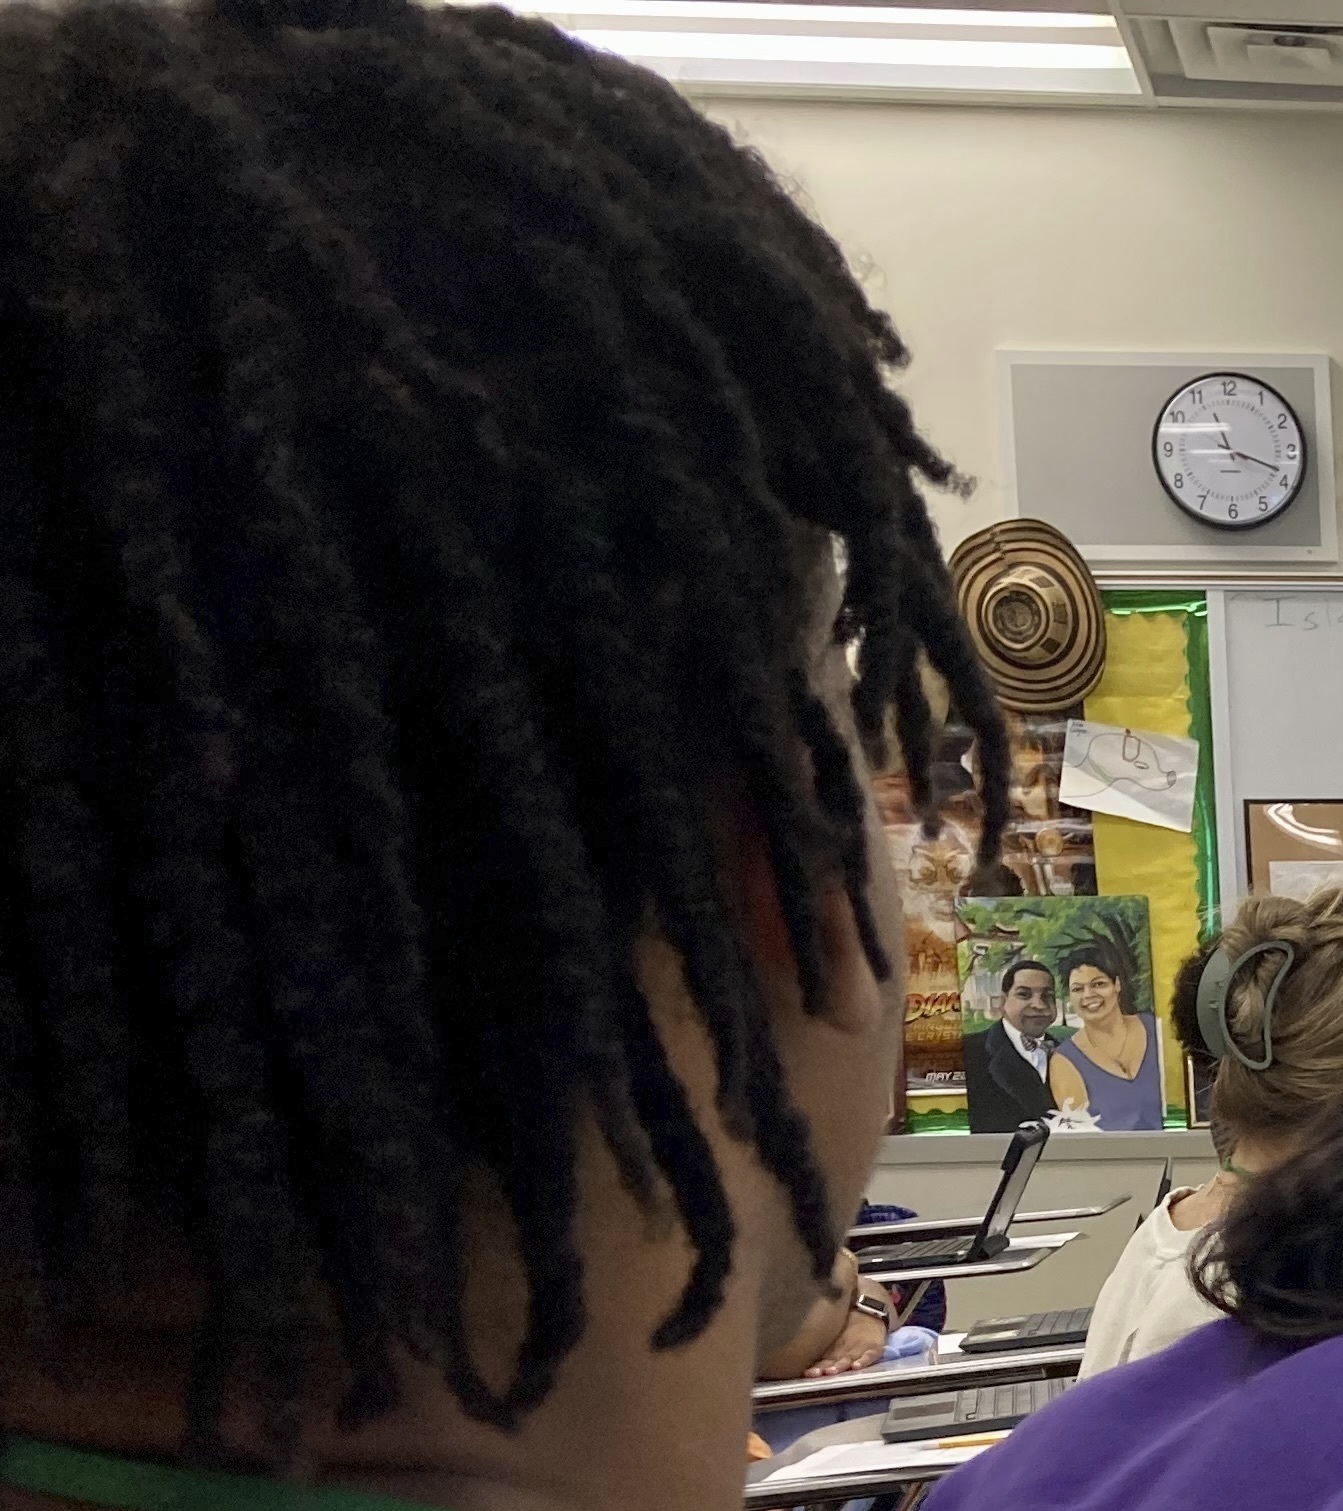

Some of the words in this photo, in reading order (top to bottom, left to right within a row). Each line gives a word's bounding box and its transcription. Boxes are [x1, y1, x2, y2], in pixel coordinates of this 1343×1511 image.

[1221, 380, 1237, 396] 12
[1189, 389, 1203, 404] 11
[1258, 390, 1264, 406] 1
[1169, 410, 1186, 423] 10
[1277, 413, 1288, 429] 2
[1163, 441, 1174, 458] 9
[1286, 443, 1297, 460] 3
[1173, 473, 1184, 489] 8
[1279, 474, 1289, 490] 4
[1197, 495, 1207, 510] 7
[1258, 496, 1268, 512] 5
[1228, 503, 1239, 519] 6
[926, 1072, 952, 1083] MAY
